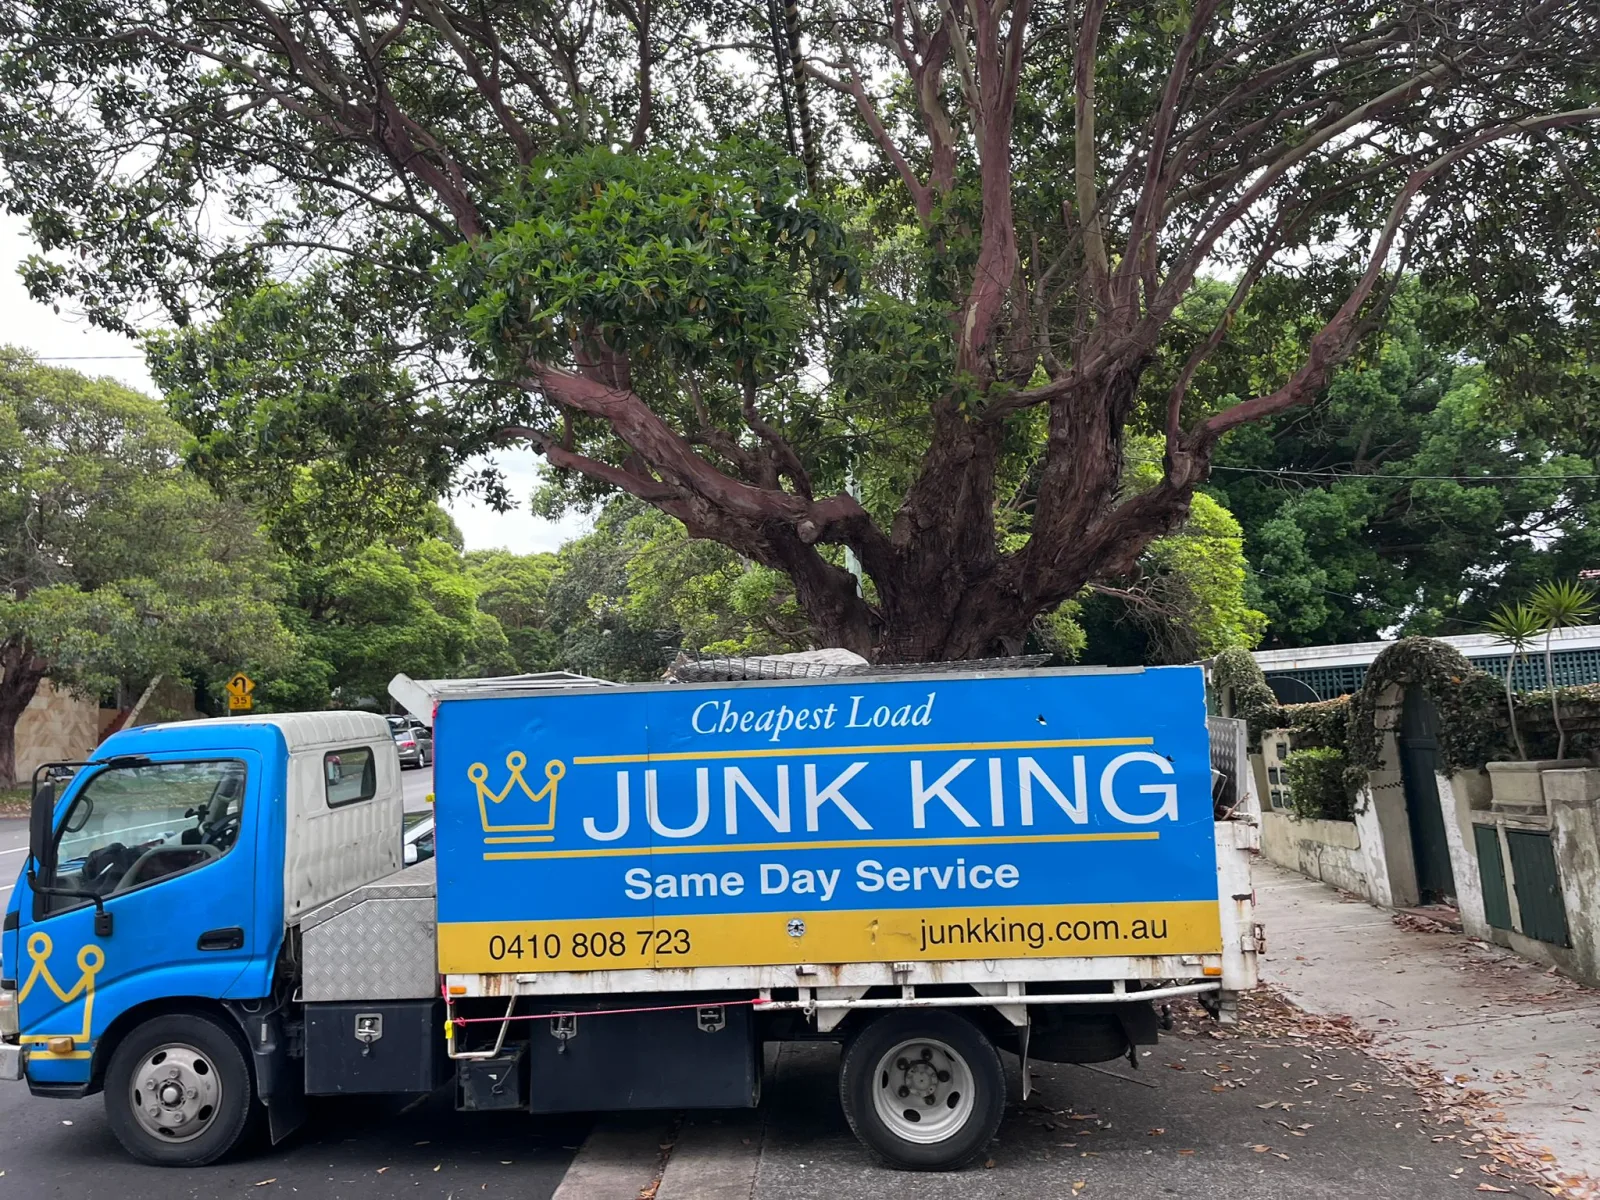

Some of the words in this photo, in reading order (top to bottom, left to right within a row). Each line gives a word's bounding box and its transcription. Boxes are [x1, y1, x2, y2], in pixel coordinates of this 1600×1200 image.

[233, 696, 247, 705] 35
[692, 699, 836, 742] Cheapest
[845, 692, 937, 729] Load
[582, 761, 874, 842] JUNK
[910, 751, 1179, 829] KING
[624, 867, 745, 901] Same
[760, 863, 841, 902] Day
[855, 858, 1020, 893] Service
[489, 934, 561, 960] 0410
[571, 931, 626, 957] 808
[636, 928, 691, 955] 723
[920, 916, 1168, 951] junkking.com.au
